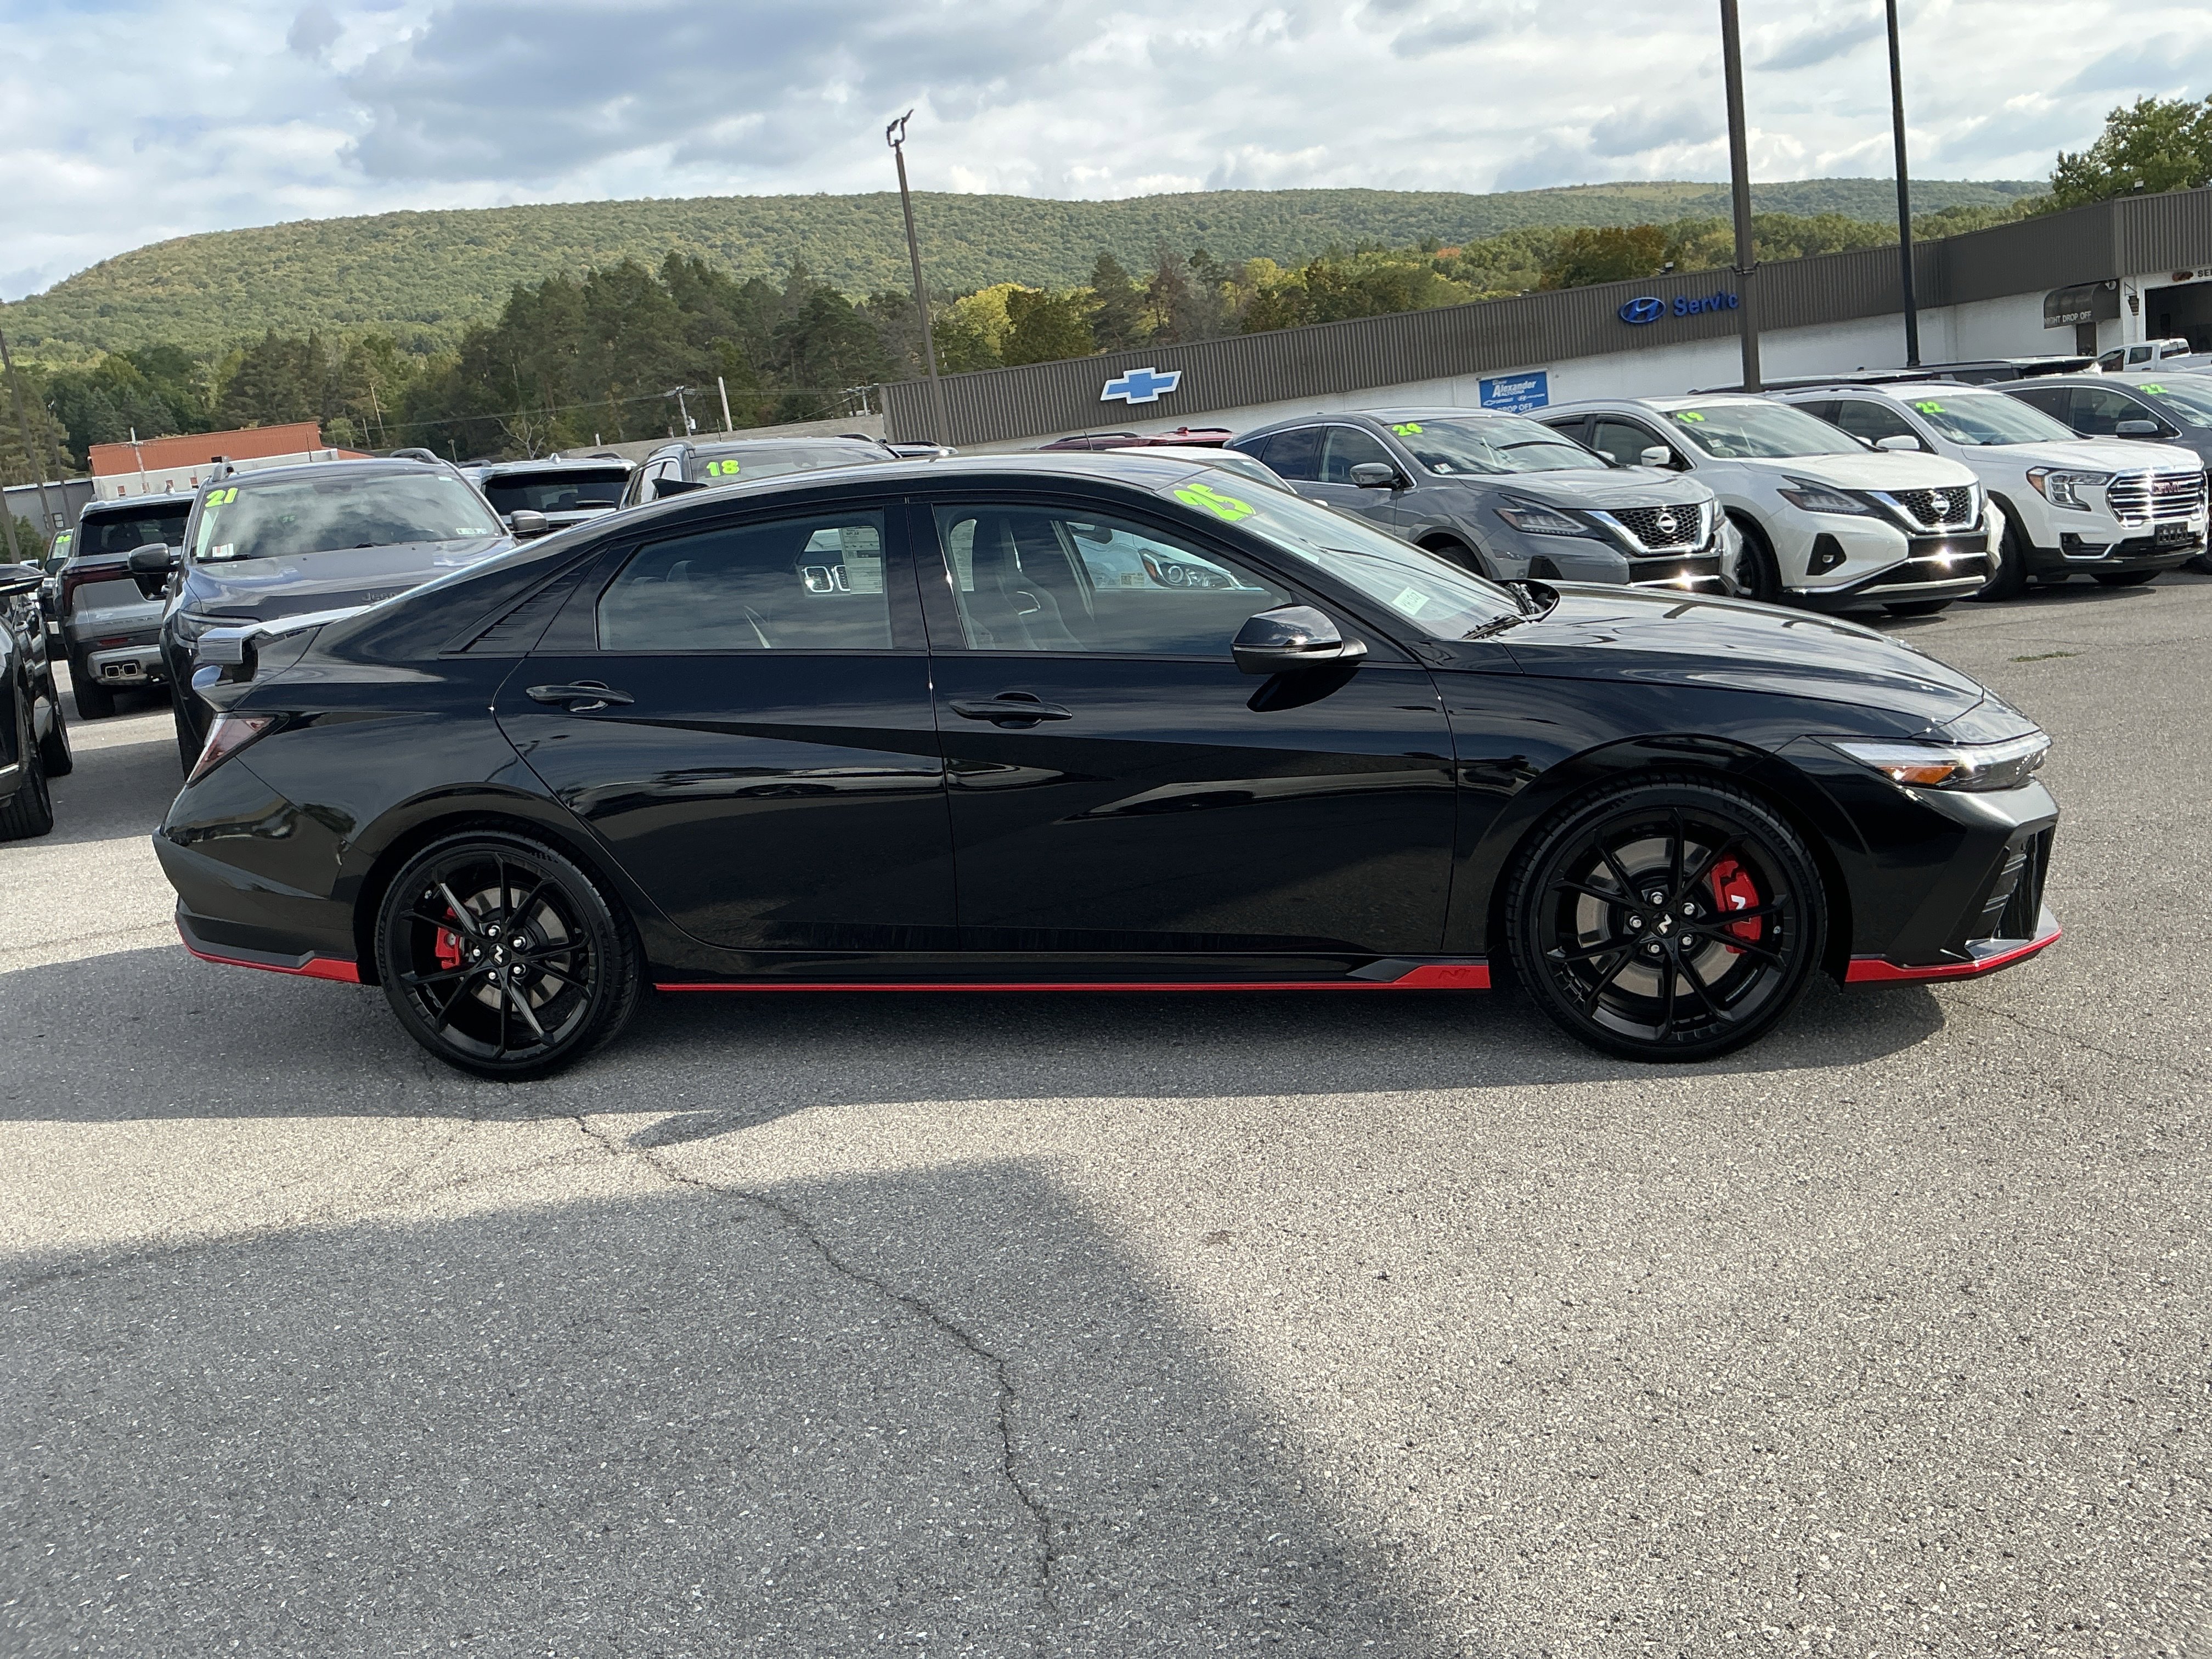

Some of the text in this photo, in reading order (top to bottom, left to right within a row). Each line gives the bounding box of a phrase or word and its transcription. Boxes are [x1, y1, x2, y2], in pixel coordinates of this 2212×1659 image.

[1673, 290, 1739, 317] Servic
[2080, 311, 2091, 320] OFF
[1492, 381, 1537, 398] Alexander
[2140, 383, 2169, 394] 22
[1519, 402, 1533, 411] OFF
[1915, 402, 1946, 414] 22
[1677, 412, 1705, 423] 19
[706, 460, 740, 477] 18
[205, 487, 239, 507] 21
[1173, 483, 1256, 521] 25
